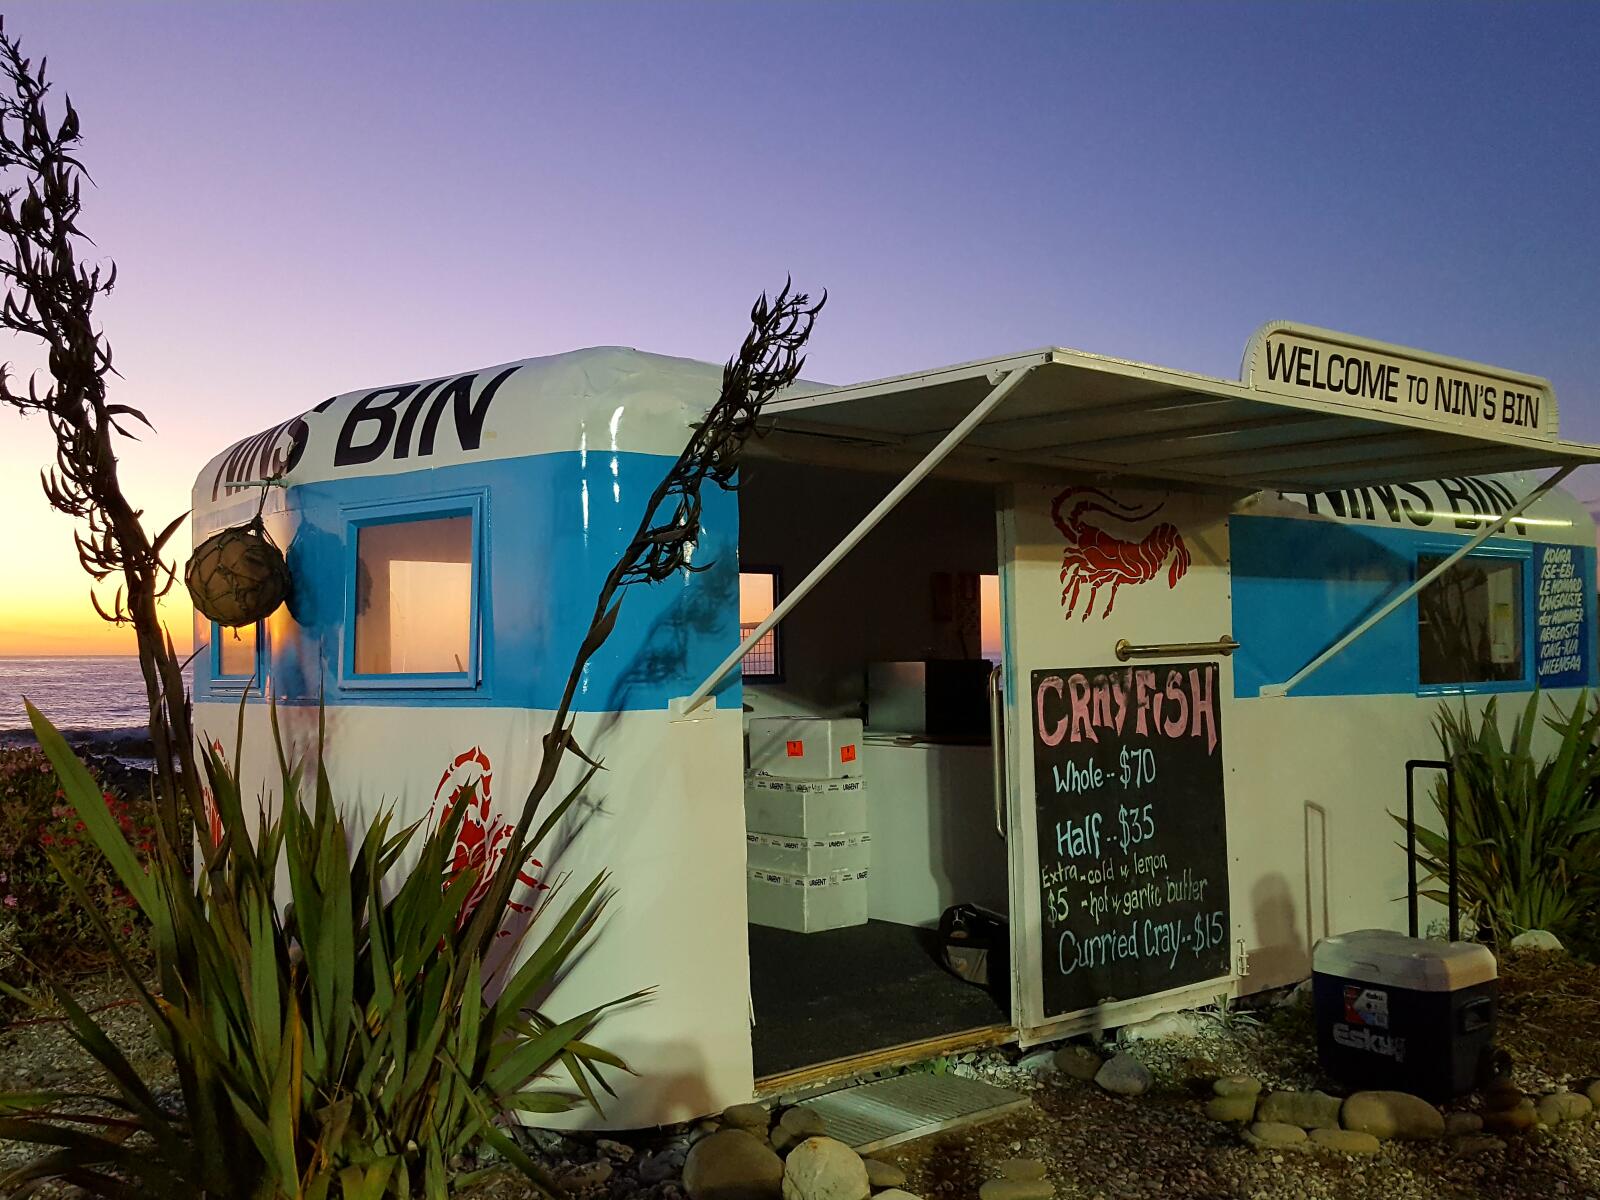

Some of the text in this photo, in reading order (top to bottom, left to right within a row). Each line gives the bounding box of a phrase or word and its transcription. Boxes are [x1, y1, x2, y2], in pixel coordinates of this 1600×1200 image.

[1266, 340, 1540, 429] WELCOME TO NIN'S BIN
[334, 366, 523, 467] BIN
[1437, 477, 1526, 535] BIN
[1539, 579, 1551, 595] LE
[1042, 861, 1078, 888] Extra
[1134, 852, 1168, 878] lemon
[1123, 883, 1162, 915] garlic
[1166, 868, 1208, 903] butter
[1059, 920, 1139, 975] Curried
